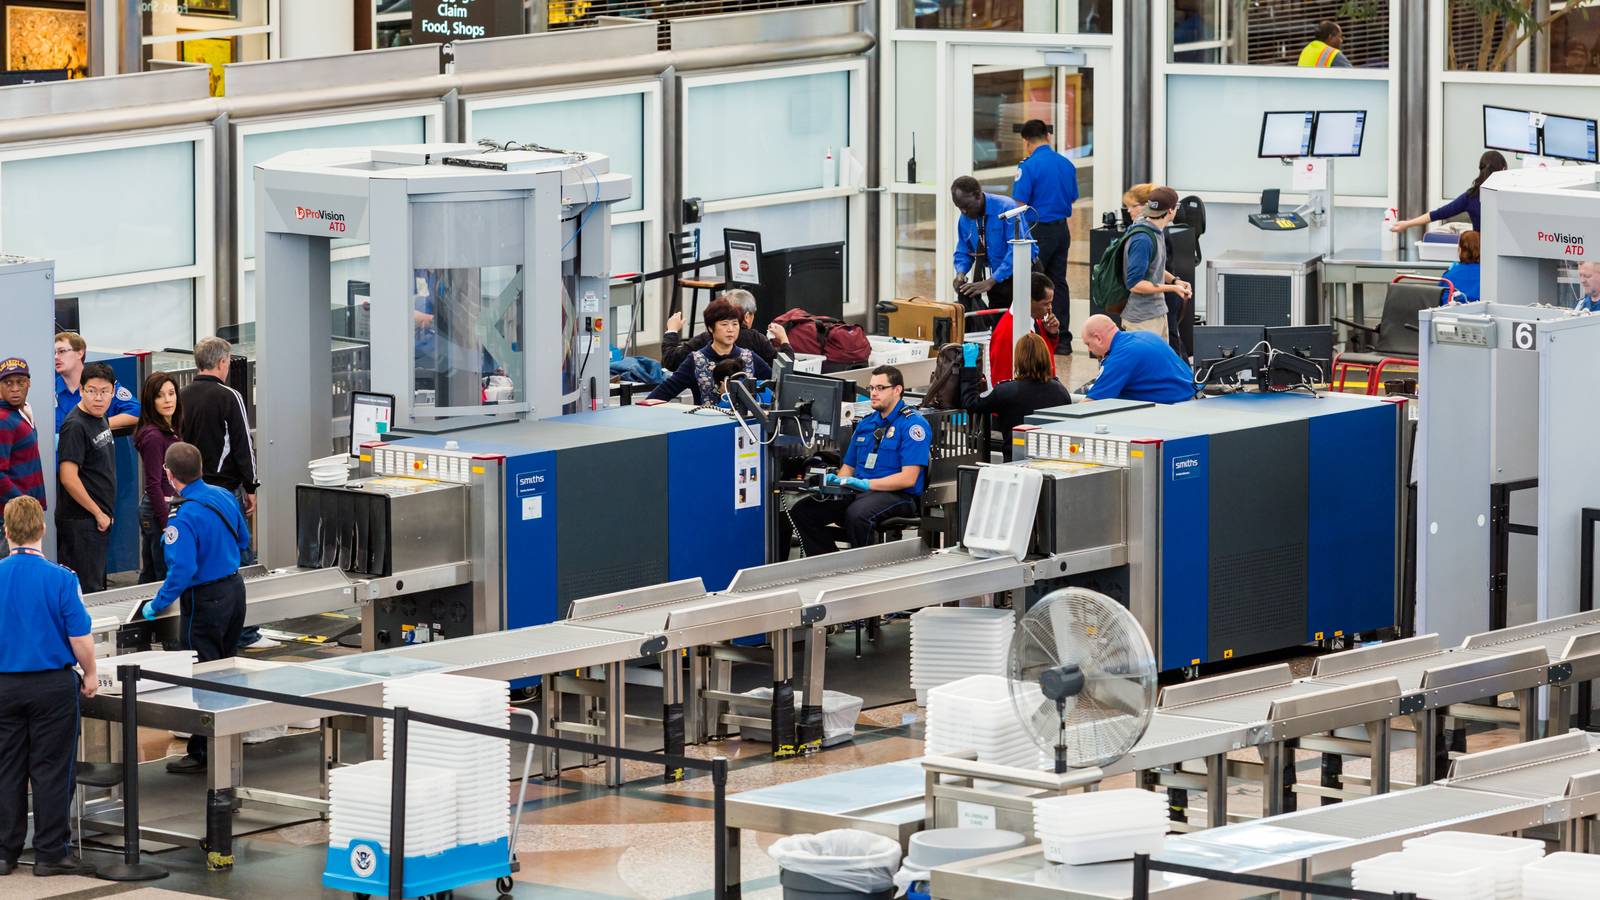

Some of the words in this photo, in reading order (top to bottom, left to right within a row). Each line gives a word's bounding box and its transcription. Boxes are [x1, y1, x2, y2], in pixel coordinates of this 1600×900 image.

[437, 4, 468, 18] Claim
[422, 19, 450, 36] Food,
[452, 22, 485, 38] Shops
[305, 208, 345, 221] ProVision
[329, 222, 346, 232] ATD
[1537, 231, 1584, 244] ProVision
[1565, 245, 1584, 256] ATD
[1515, 322, 1533, 349] 6
[519, 475, 545, 485] smiths
